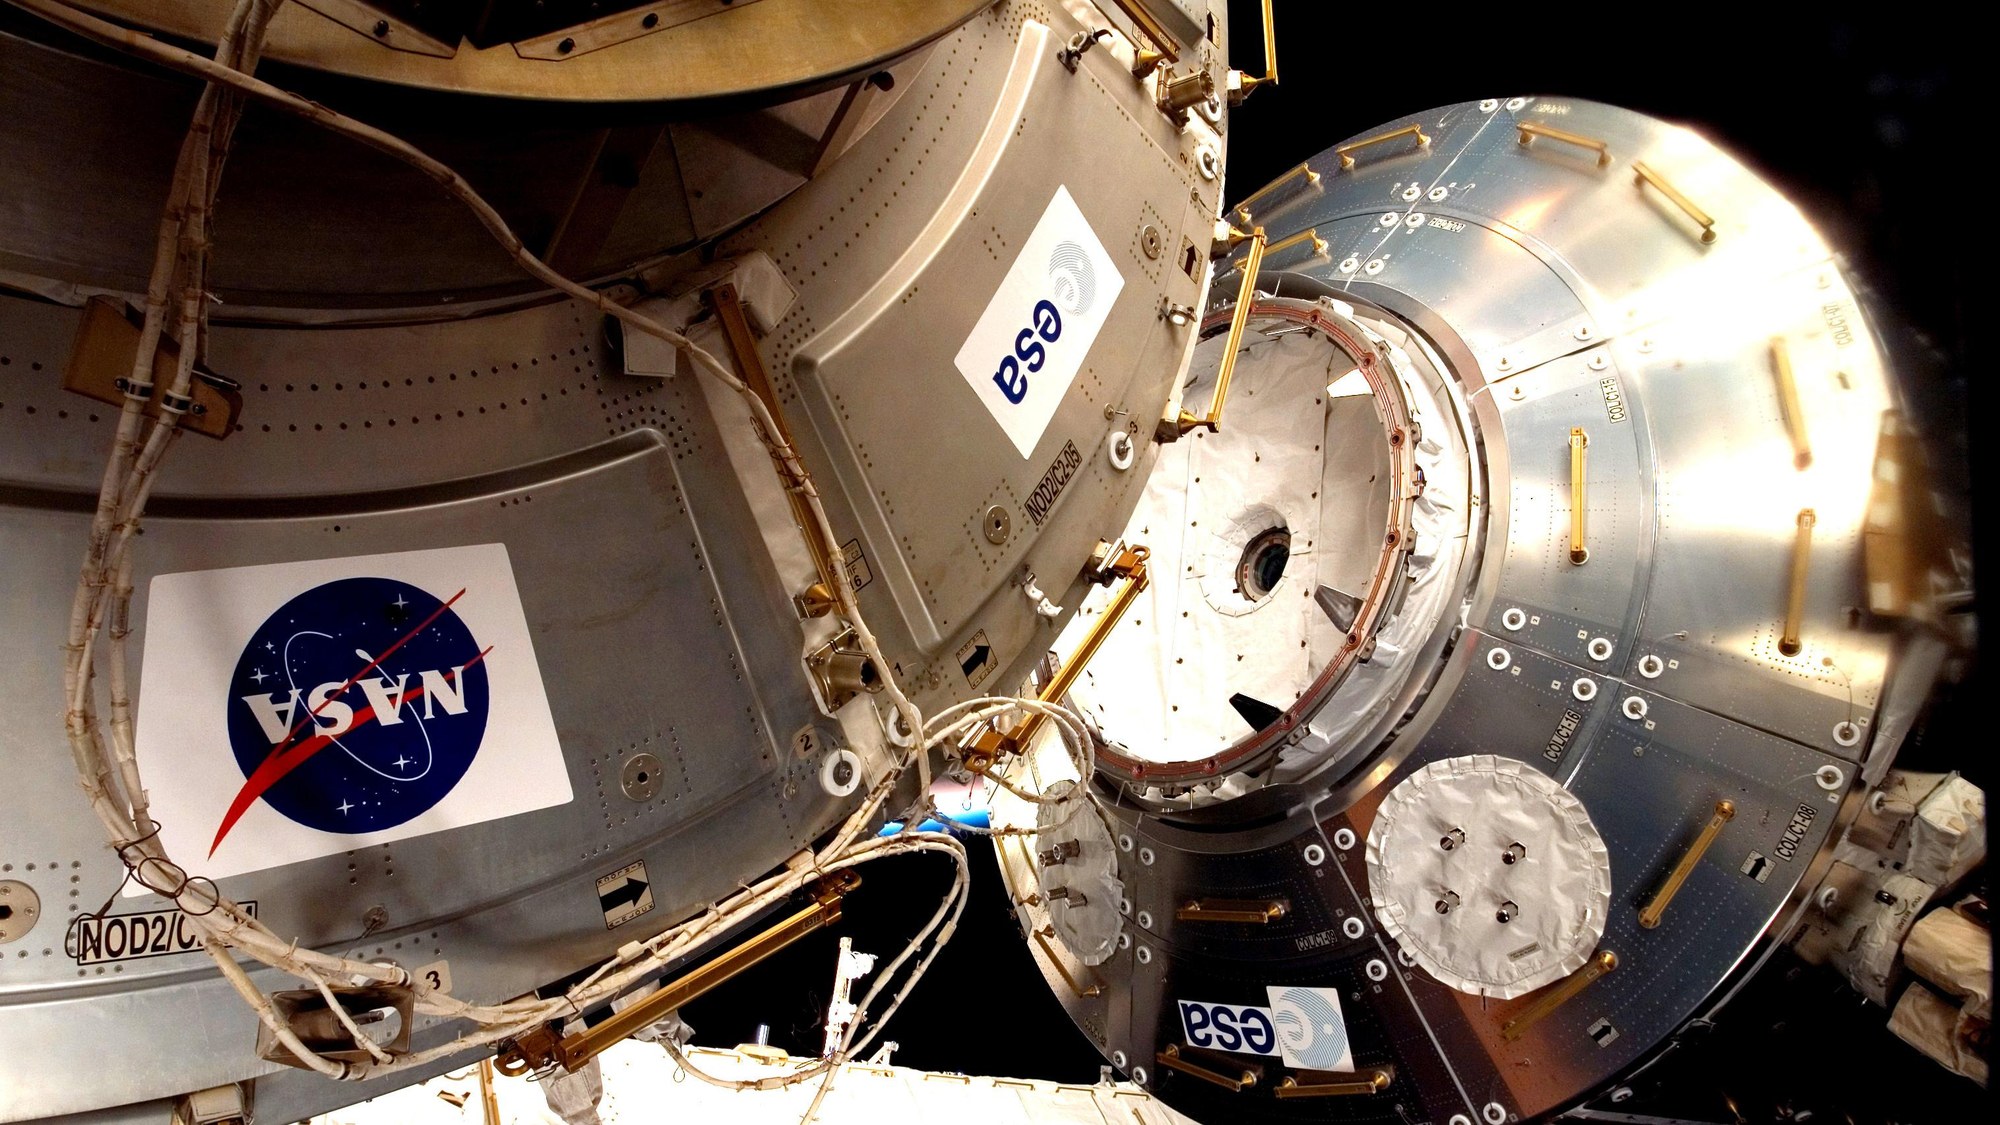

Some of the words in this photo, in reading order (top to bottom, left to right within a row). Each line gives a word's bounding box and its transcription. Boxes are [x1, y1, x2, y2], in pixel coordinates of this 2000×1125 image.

[992, 299, 1062, 405] esa
[1602, 378, 1624, 420] COL/C1-15
[1026, 443, 1082, 522] NOD2/C2-05
[241, 664, 469, 745] NASA
[798, 734, 814, 752] 2
[1544, 711, 1581, 759] COL/C1-16
[1776, 804, 1816, 859] COL/C1-08
[81, 906, 255, 961] NOD2/C
[425, 970, 441, 990] 3
[1182, 1002, 1276, 1055] esa
